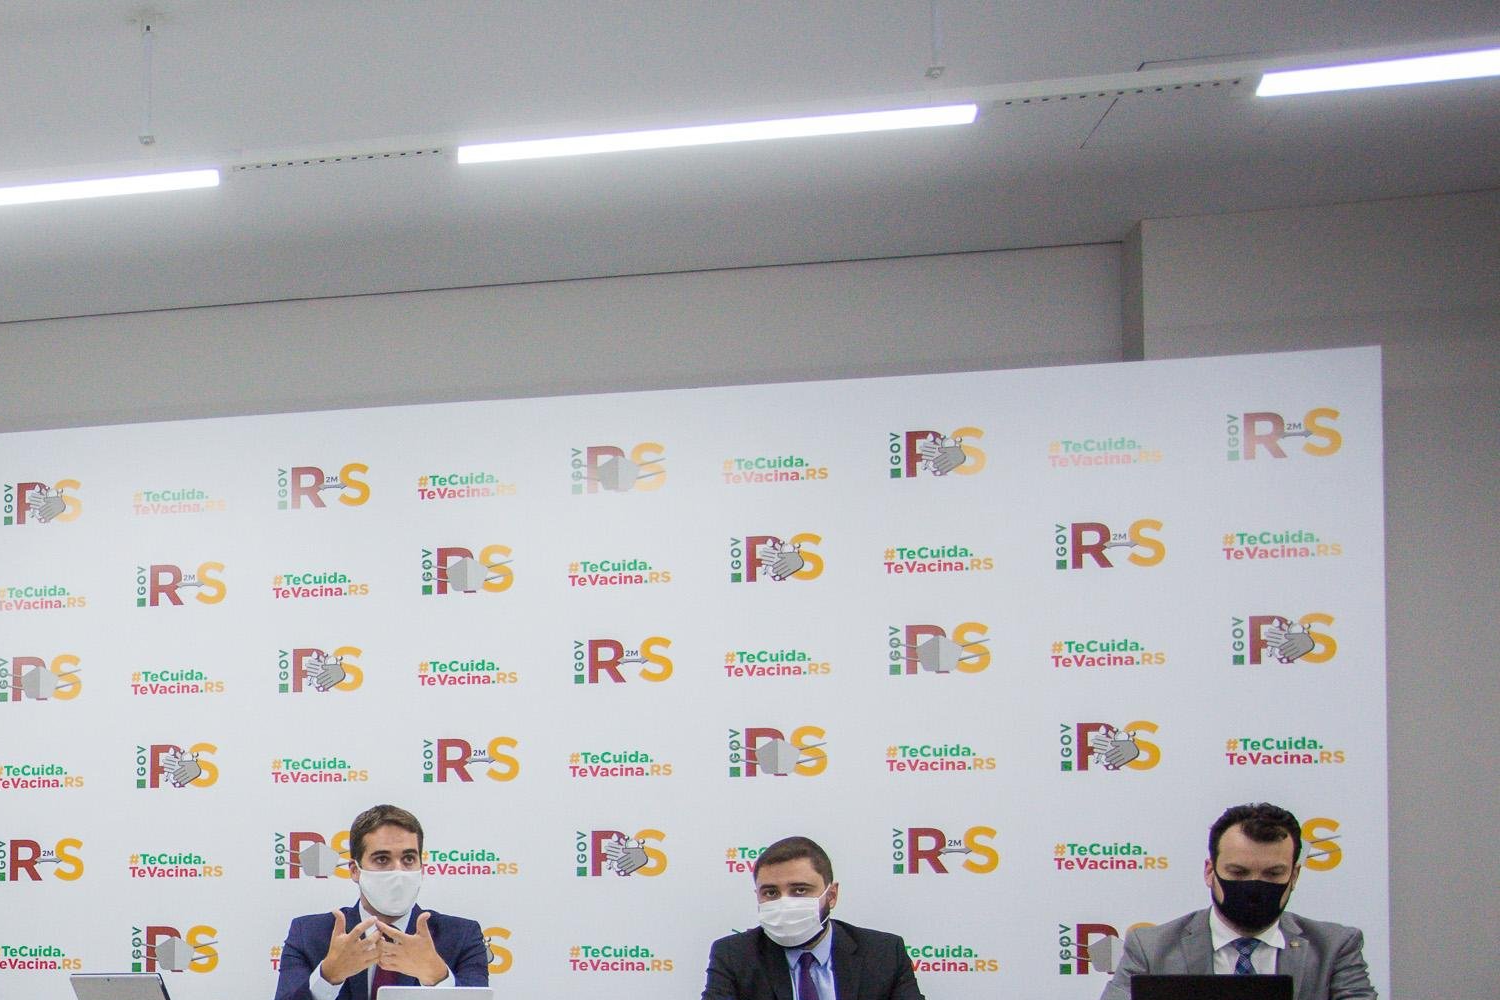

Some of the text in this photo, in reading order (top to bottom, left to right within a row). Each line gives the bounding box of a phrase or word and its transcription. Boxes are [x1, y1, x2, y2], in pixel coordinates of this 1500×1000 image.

[418, 472, 499, 487] #TeCuida.
[725, 467, 828, 482] TeVacina.RS
[1112, 533, 1127, 541] 2M
[1223, 530, 1320, 546] #TeCuida.
[884, 545, 973, 560] #TeCuida.
[1222, 544, 1341, 560] TeVacina.RS
[569, 559, 652, 573] #TeCuida.
[884, 558, 993, 574] TeVacina.RS
[274, 572, 351, 586] #TeCuida.
[568, 571, 670, 587] TeVacina.RS
[272, 584, 368, 599] TeVacina.RS
[1052, 639, 1144, 653] #TeCuida.
[725, 649, 811, 664] #TeCuida.
[1051, 653, 1165, 668] TeVacina.RS
[419, 659, 499, 673] #TeCuida.
[724, 663, 830, 677] TeVacina.RS
[132, 669, 208, 682] #TeCuida.
[418, 672, 517, 686] TeVacina.RS
[131, 682, 224, 695] TeVacina.RS
[1227, 736, 1323, 750] #TeCuida.
[570, 751, 654, 764] #TeCuida.
[886, 744, 976, 757] #TeCuida.
[272, 757, 351, 770] #TeCuida.
[886, 758, 996, 772] TeVacina.RS
[1225, 751, 1344, 765] TeVacina.RS
[271, 770, 368, 783] TeVacina.RS
[569, 764, 672, 778] TeVacina.RS
[947, 839, 962, 847] 2M
[1054, 842, 1147, 856] #TeCuida.
[130, 853, 206, 865] #TeCuida.
[1054, 857, 1168, 870] TeVacina.RS
[129, 866, 222, 878] TeVacina.RS
[570, 945, 654, 958] #TeCuida.
[569, 959, 673, 971] TeVacina.RS
